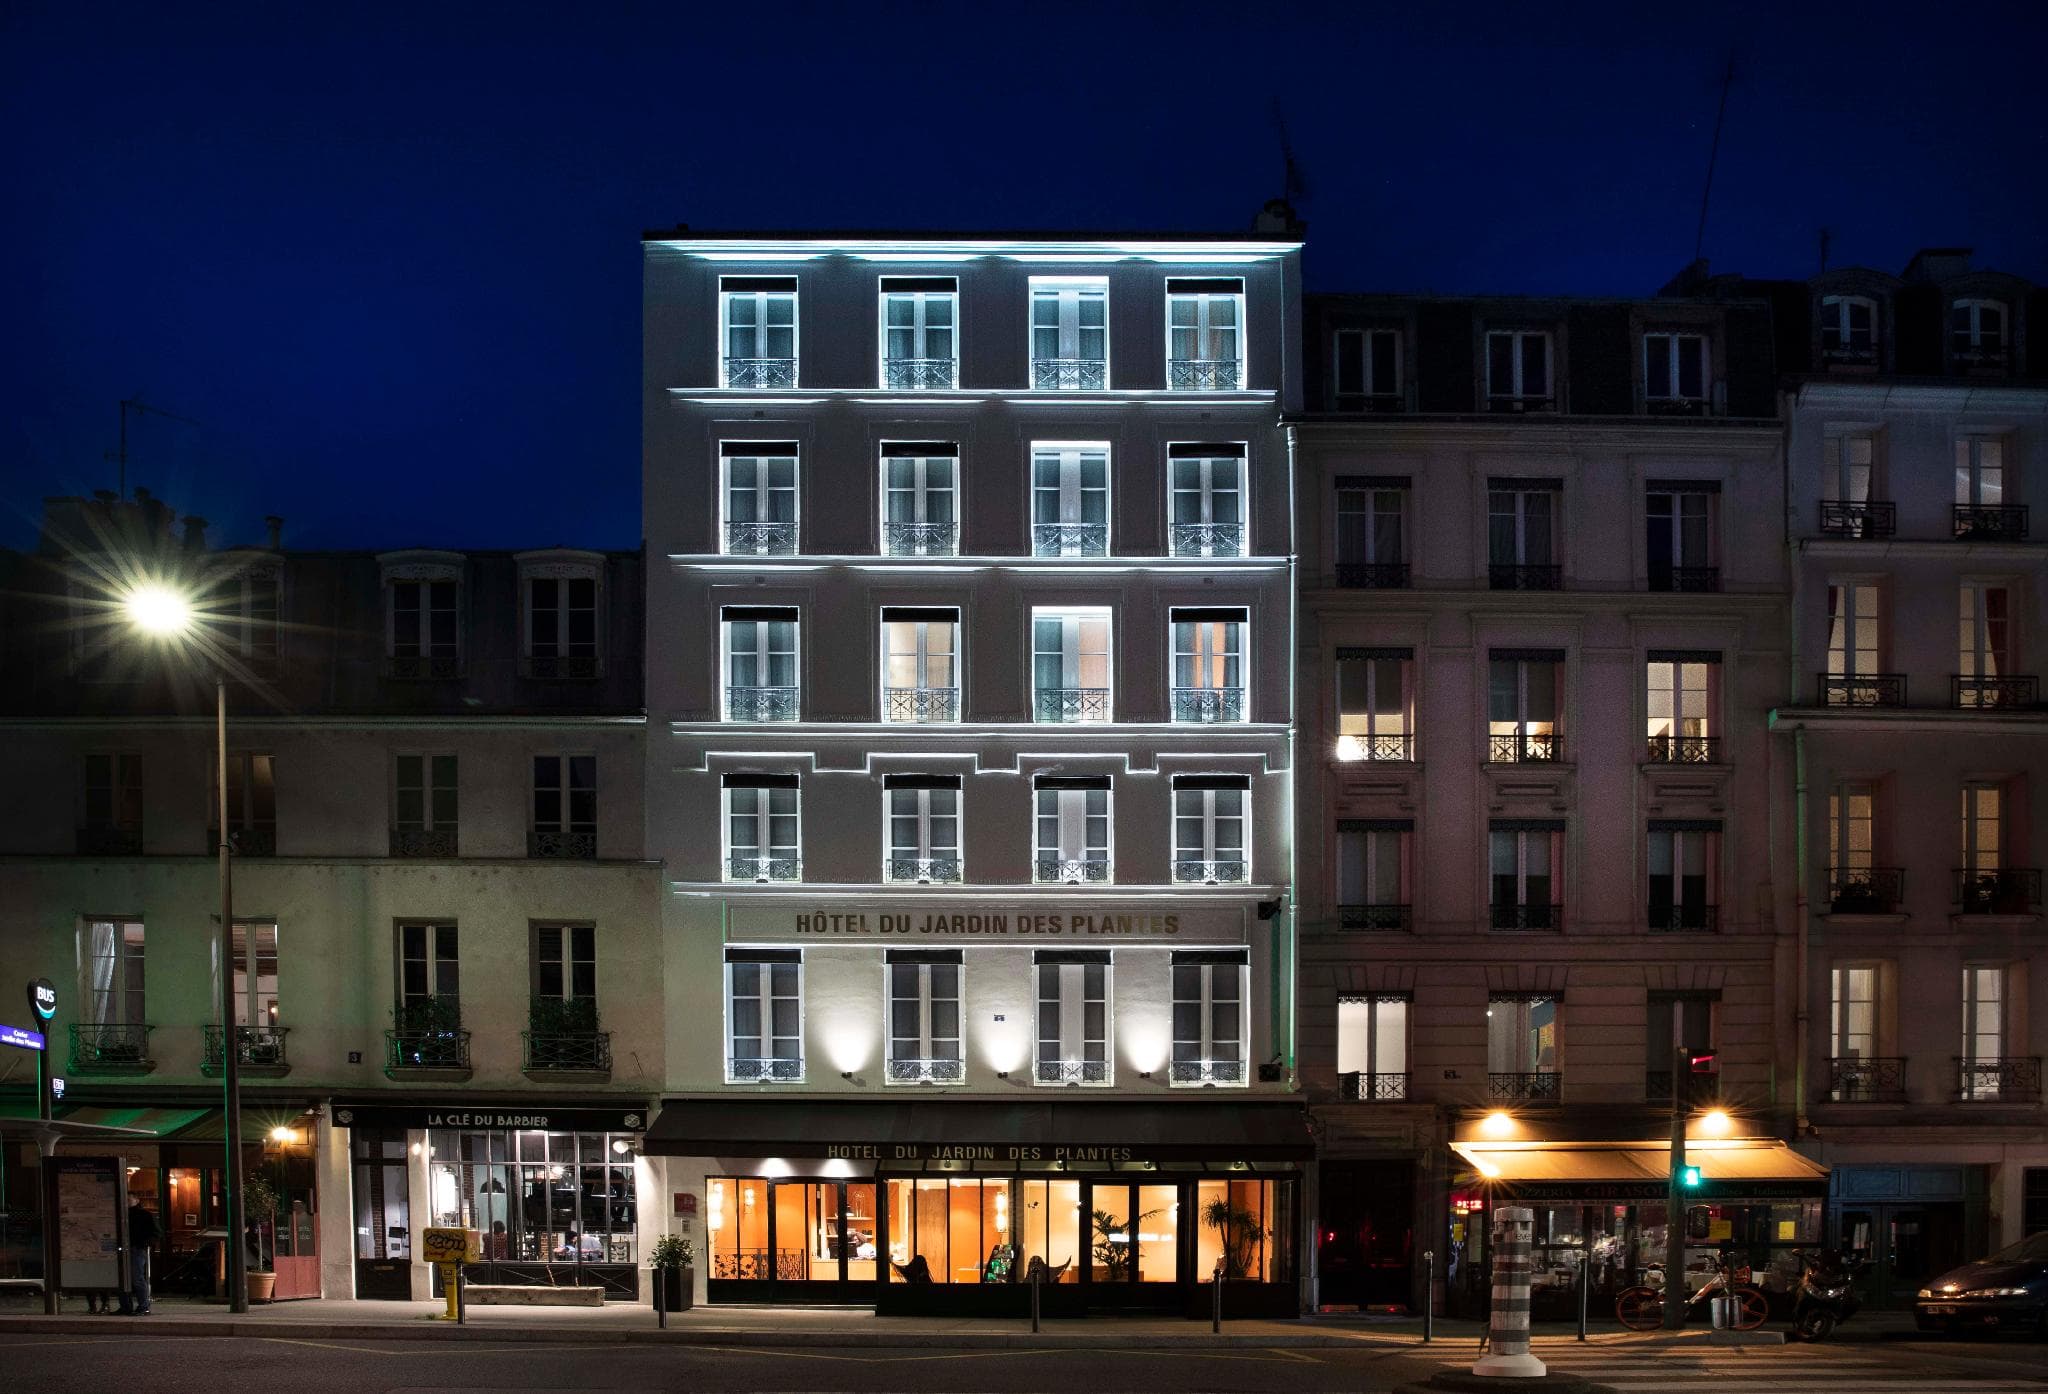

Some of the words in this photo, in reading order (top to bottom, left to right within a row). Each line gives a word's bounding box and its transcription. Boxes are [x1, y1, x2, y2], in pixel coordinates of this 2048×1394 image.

[797, 911, 870, 934] HÔTEL
[879, 914, 911, 934] DU
[919, 914, 1007, 935] JARDIN
[1017, 916, 1061, 935] DES
[1070, 916, 1178, 935] PLANTES
[36, 987, 55, 1003] BUS
[428, 1115, 442, 1126] LA
[447, 1113, 470, 1126] CLÉ
[475, 1116, 493, 1126] DU
[497, 1117, 549, 1127] BARBIER
[828, 1146, 881, 1159] HOTEL
[895, 1146, 917, 1159] DU
[931, 1146, 994, 1159] JARDIN
[1009, 1147, 1041, 1160] DES
[1055, 1147, 1132, 1160] PLANTES
[1583, 1185, 1668, 1197] GIRASOL
